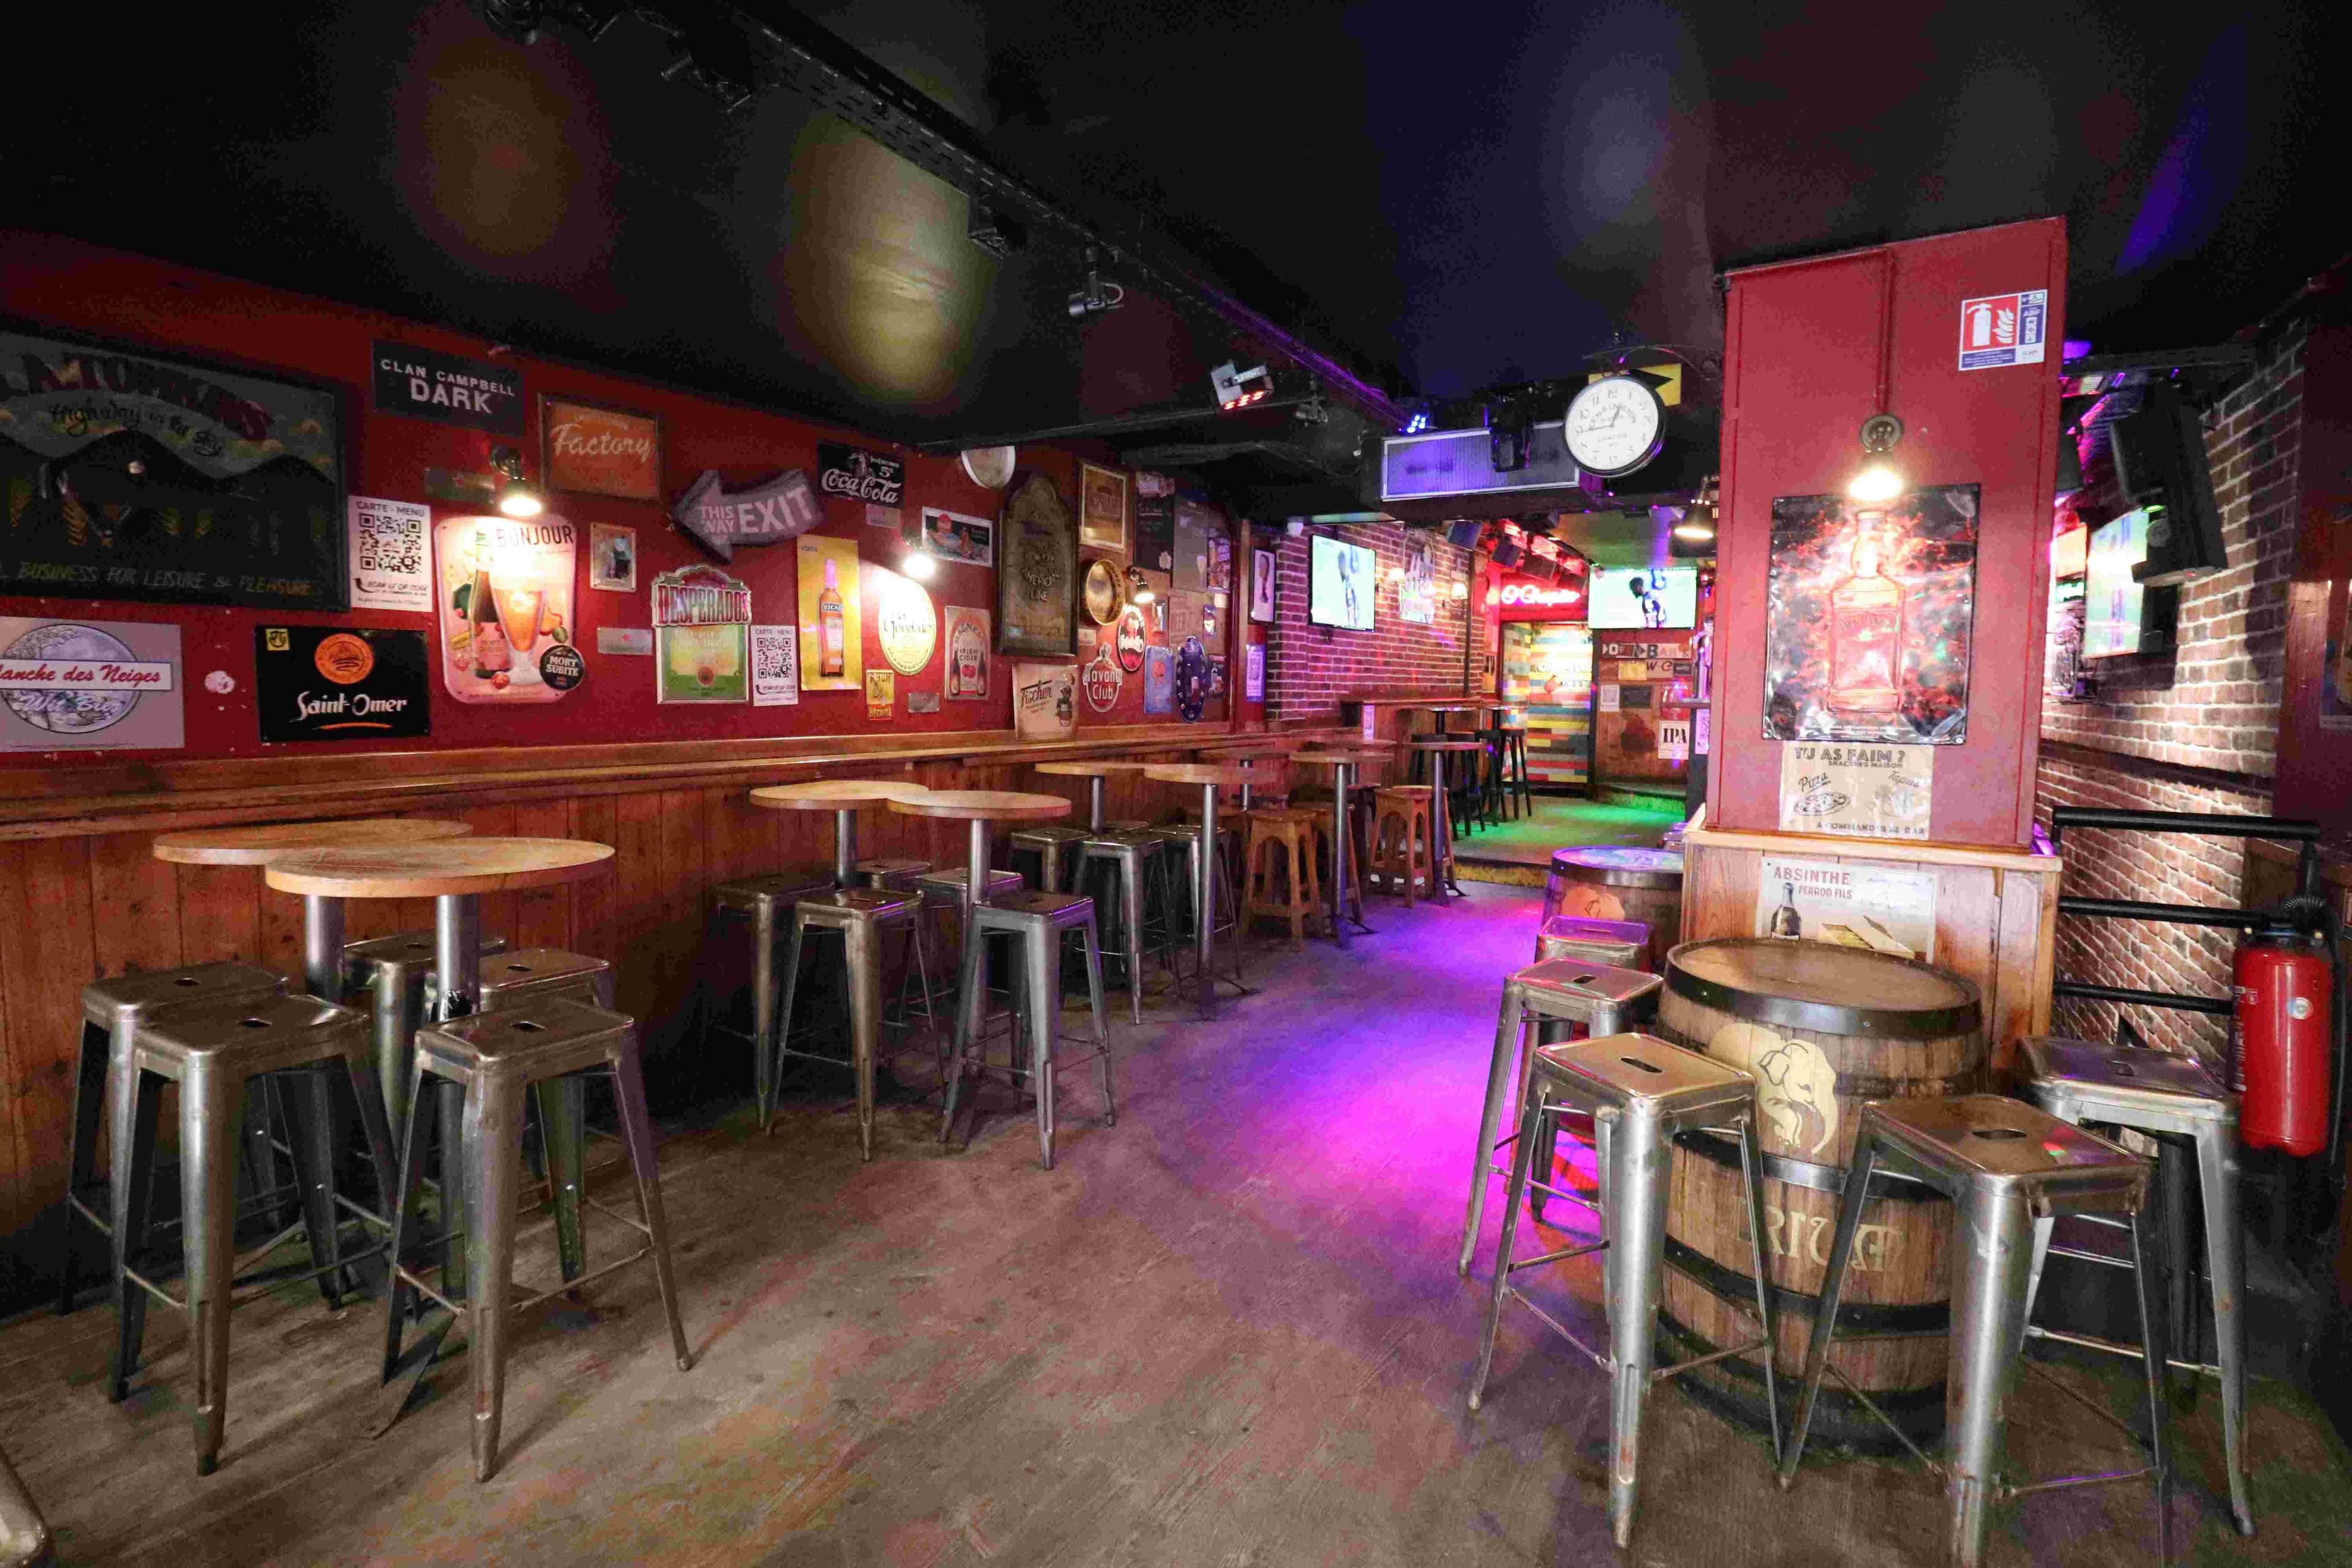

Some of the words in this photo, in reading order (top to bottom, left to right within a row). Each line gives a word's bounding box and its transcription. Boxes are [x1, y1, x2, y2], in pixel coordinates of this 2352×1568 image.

[381, 358, 427, 377] CLAN
[435, 371, 516, 397] CAMPBELL
[410, 379, 492, 414] DARK
[550, 423, 652, 464] Factory
[821, 469, 860, 496] Coca
[860, 477, 902, 503] Cola
[356, 501, 388, 513] CARTE
[396, 506, 425, 517] MENU
[700, 504, 734, 522] THIS
[739, 484, 813, 534] EXIT
[704, 516, 734, 533] WAY
[496, 524, 575, 548] BONJOUR
[17, 560, 98, 582] BUSINESS
[143, 569, 208, 588] LEISURE
[1020, 567, 1060, 587] AMERICAN
[658, 585, 748, 625] DESPERADOS
[546, 663, 579, 677] SUBITE
[549, 655, 578, 668] MORT
[0, 663, 56, 682] lanche
[63, 665, 94, 682] des
[99, 663, 162, 688] Neiges
[1020, 679, 1053, 708] Fischer
[1091, 686, 1114, 700] Club
[288, 690, 408, 723] Saint-Omer
[1663, 728, 1687, 744] IPA
[1794, 747, 1815, 760] TU
[1820, 748, 1842, 761] AS
[1847, 748, 1893, 762] FAIM
[1897, 750, 1906, 763] ?
[1798, 772, 1830, 793] Pizza
[1888, 770, 1920, 788] Tapas
[1825, 823, 1887, 833] OMMANDR
[1774, 866, 1851, 886] ABSINTHE
[1834, 888, 1853, 899] FILS
